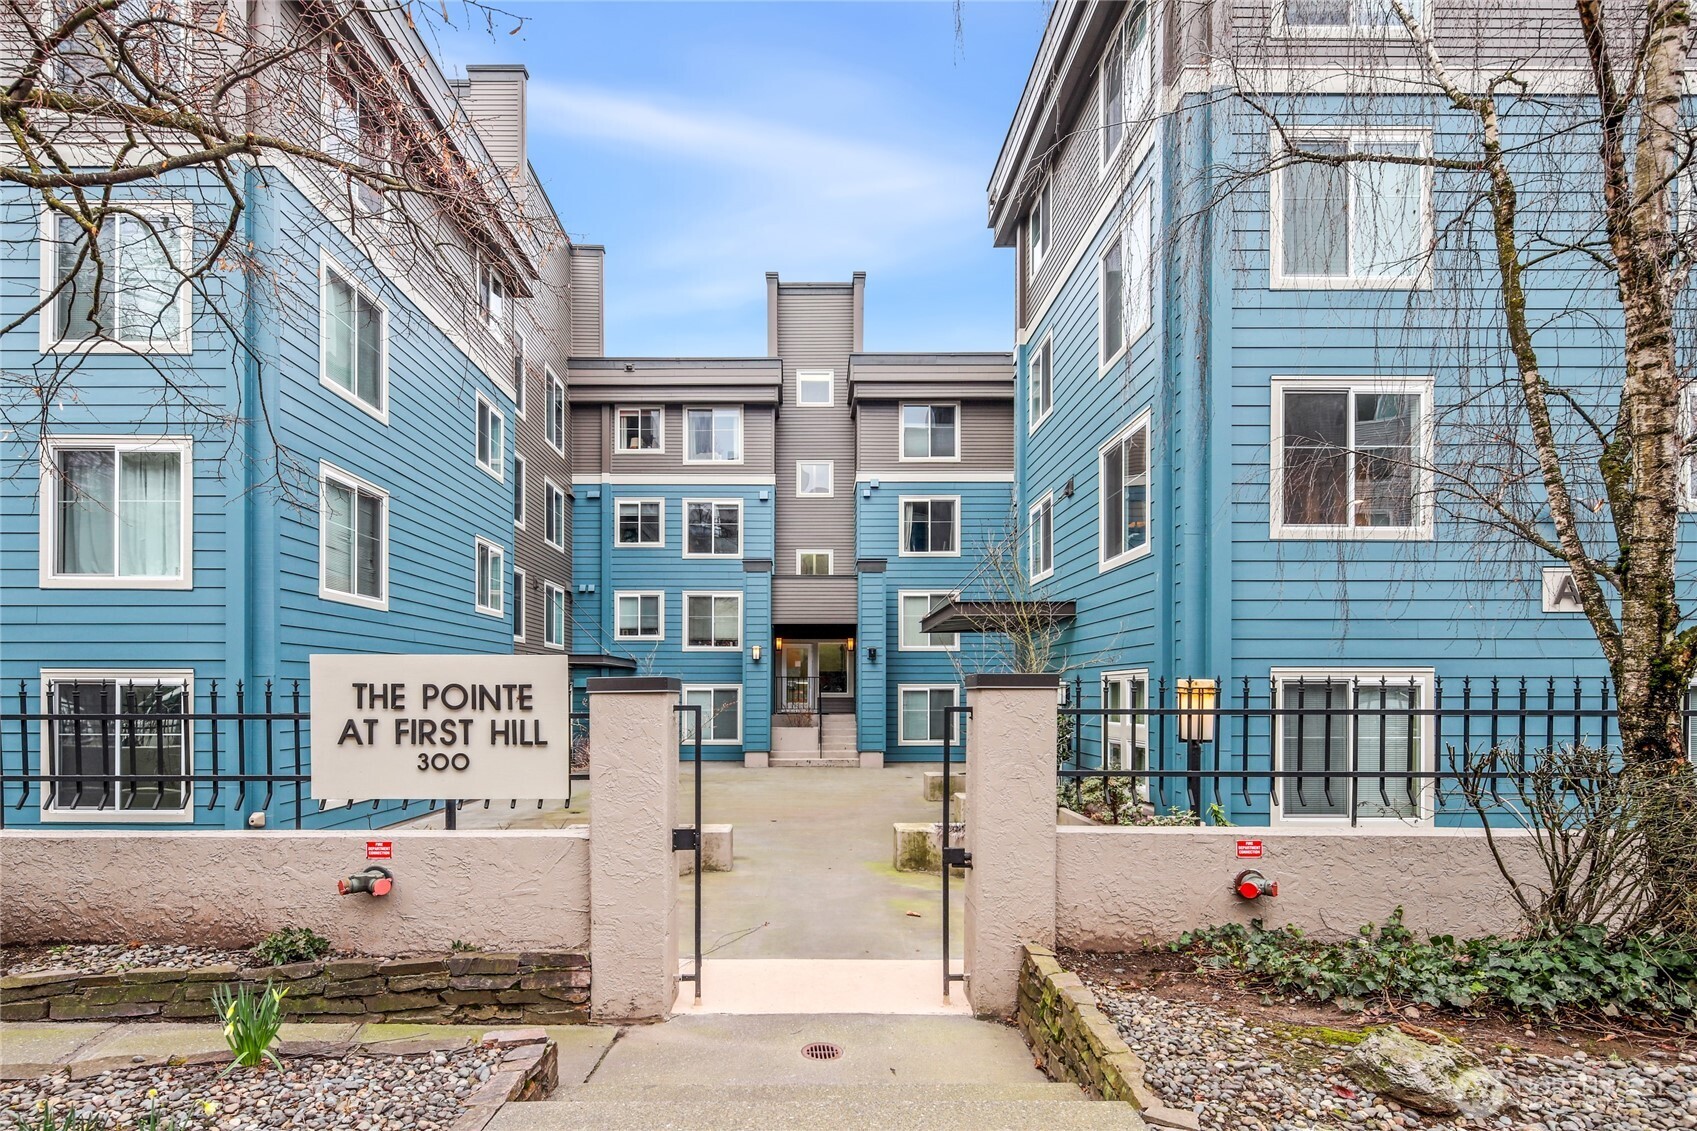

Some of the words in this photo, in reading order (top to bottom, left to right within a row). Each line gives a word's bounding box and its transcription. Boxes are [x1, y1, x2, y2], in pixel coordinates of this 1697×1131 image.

[1553, 574, 1584, 605] A
[352, 682, 405, 710] THE
[422, 683, 533, 711] POINTE
[337, 718, 379, 746] AT
[394, 718, 474, 746] FIRST
[490, 719, 548, 746] HILL
[417, 752, 470, 771] 300
